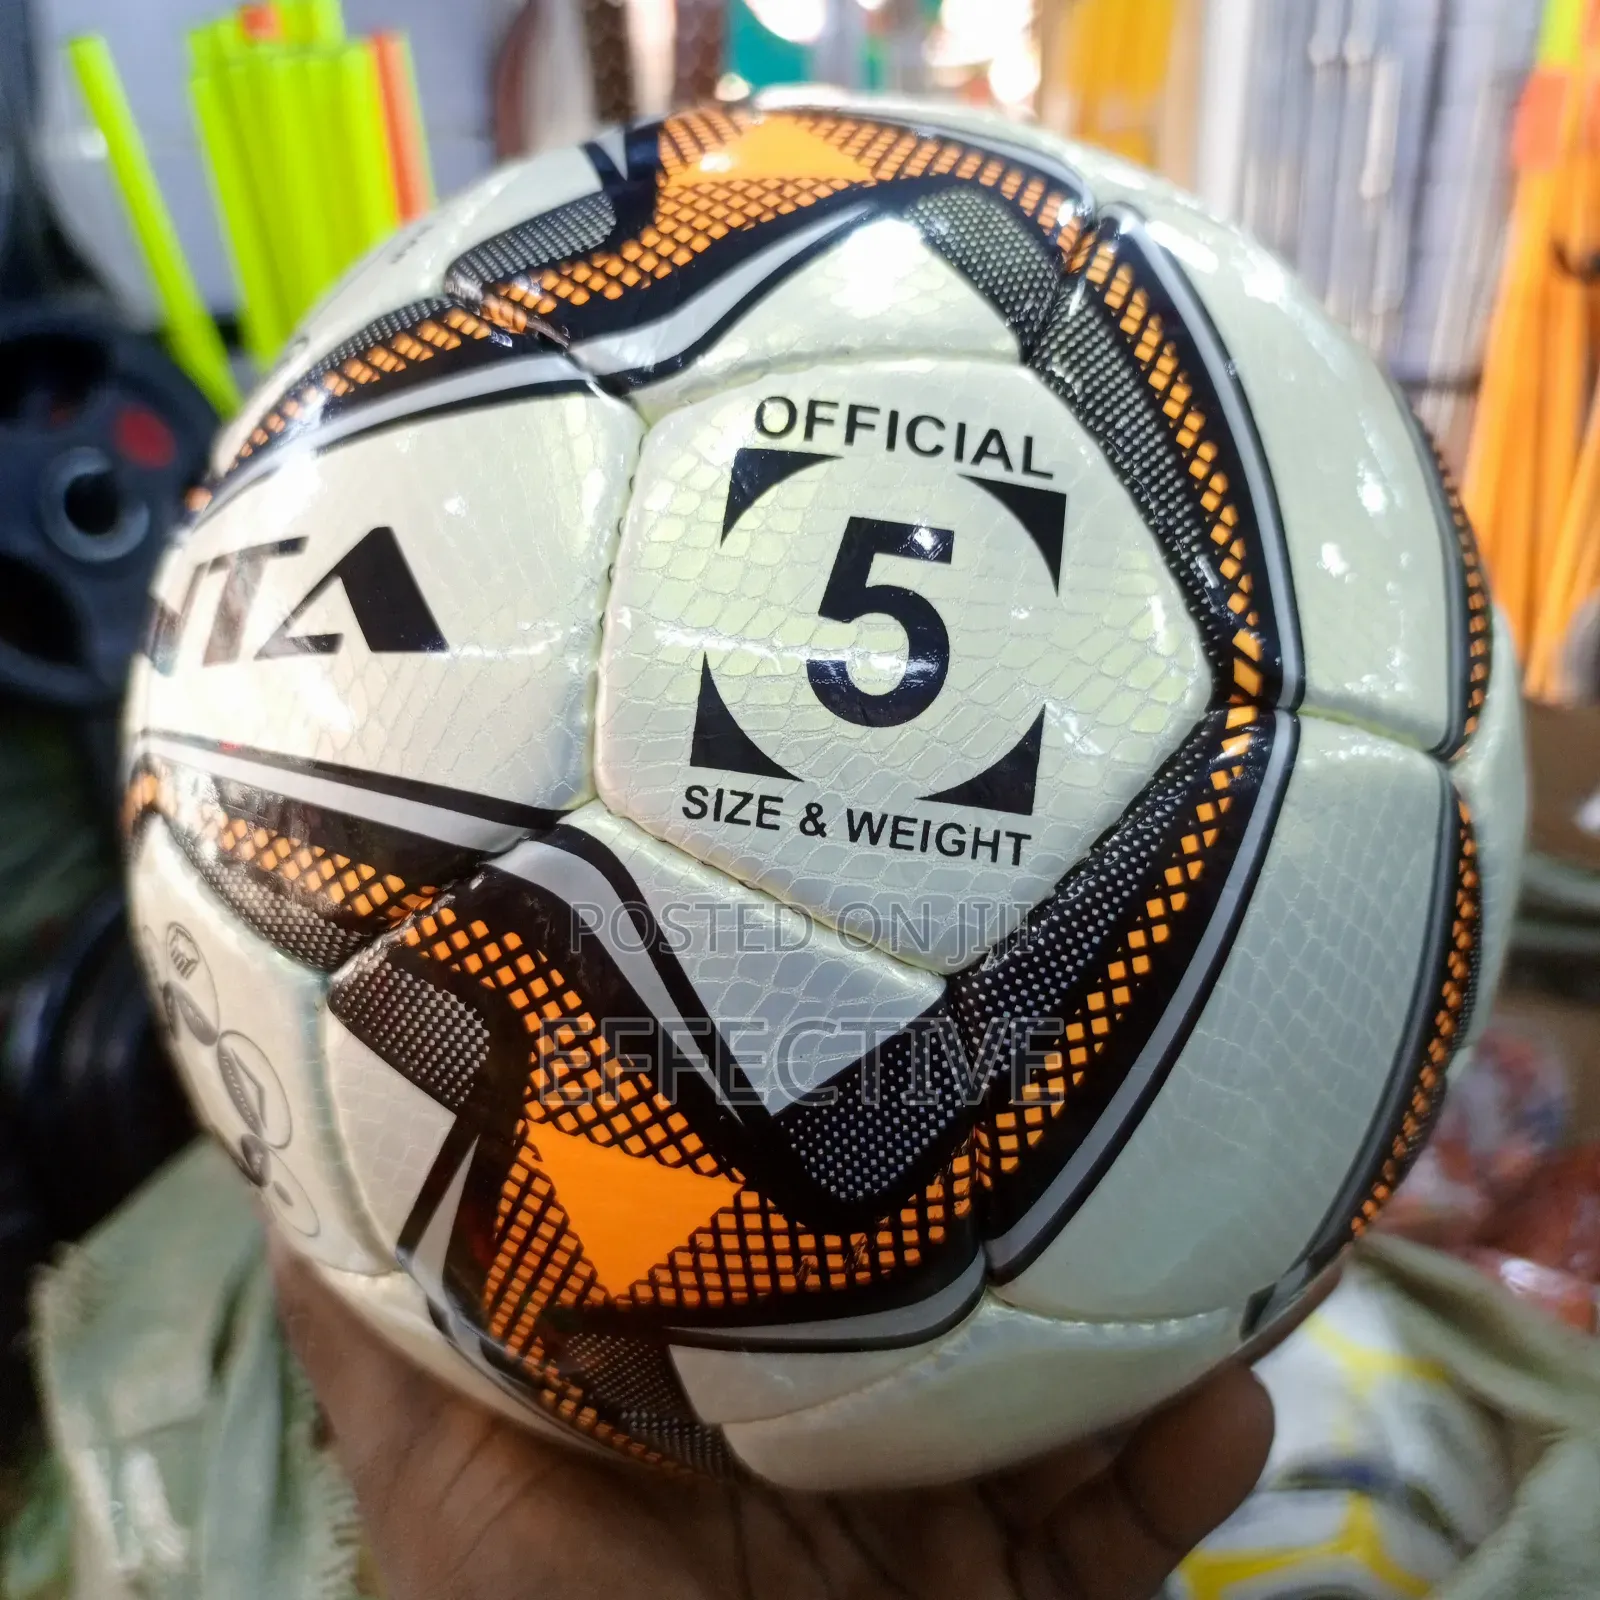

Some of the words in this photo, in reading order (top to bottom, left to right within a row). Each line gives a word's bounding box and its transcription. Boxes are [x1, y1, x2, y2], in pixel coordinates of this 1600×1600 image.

[754, 395, 1055, 480] OFFICIAL
[806, 516, 955, 728] 5
[682, 784, 782, 831] SIZE
[799, 802, 827, 837] &
[846, 808, 1032, 867] WEIGHT
